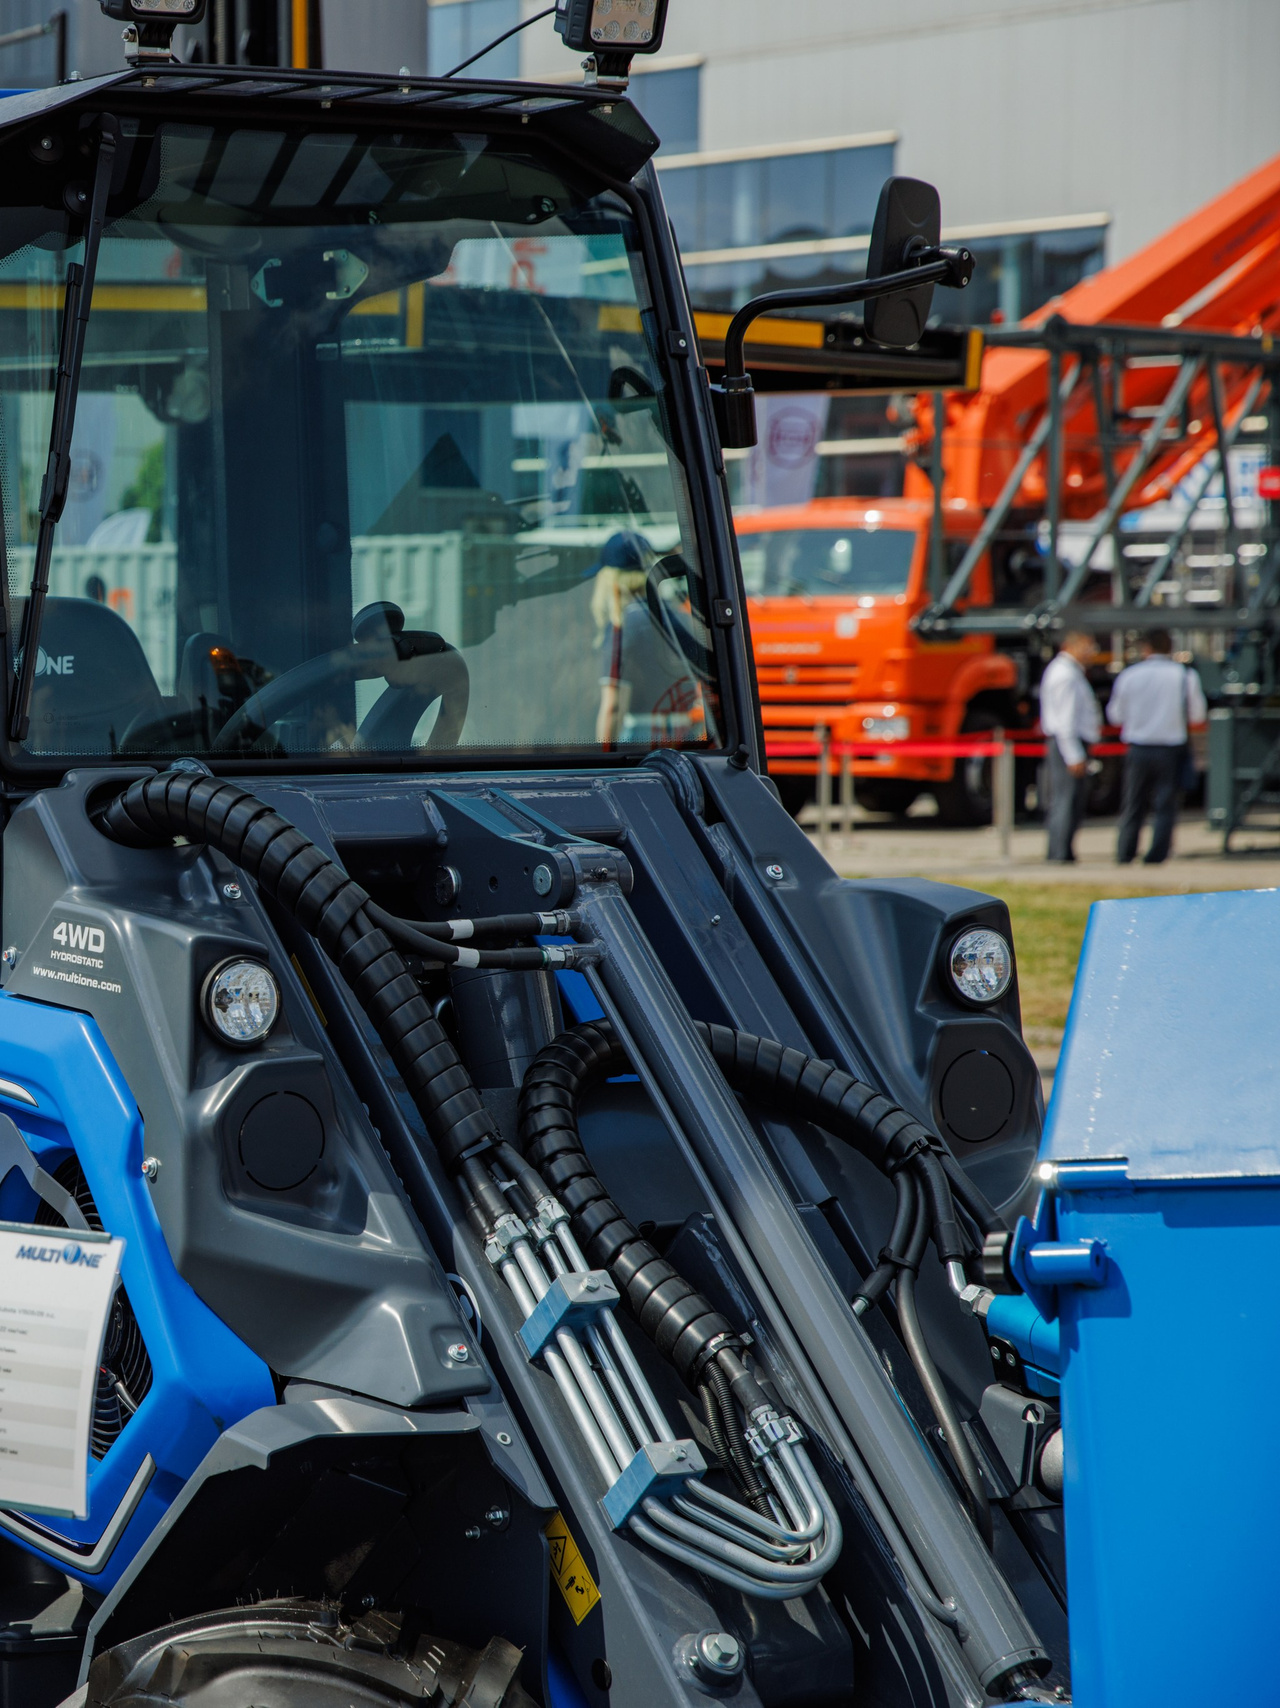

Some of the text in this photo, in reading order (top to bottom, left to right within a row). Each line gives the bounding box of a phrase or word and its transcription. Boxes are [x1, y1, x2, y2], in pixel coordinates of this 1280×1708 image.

[53, 921, 105, 954] 4WD
[50, 950, 104, 969] HYDROSTATIC
[33, 966, 122, 994] www.multione.com
[15, 1241, 103, 1268] MULTIONE
